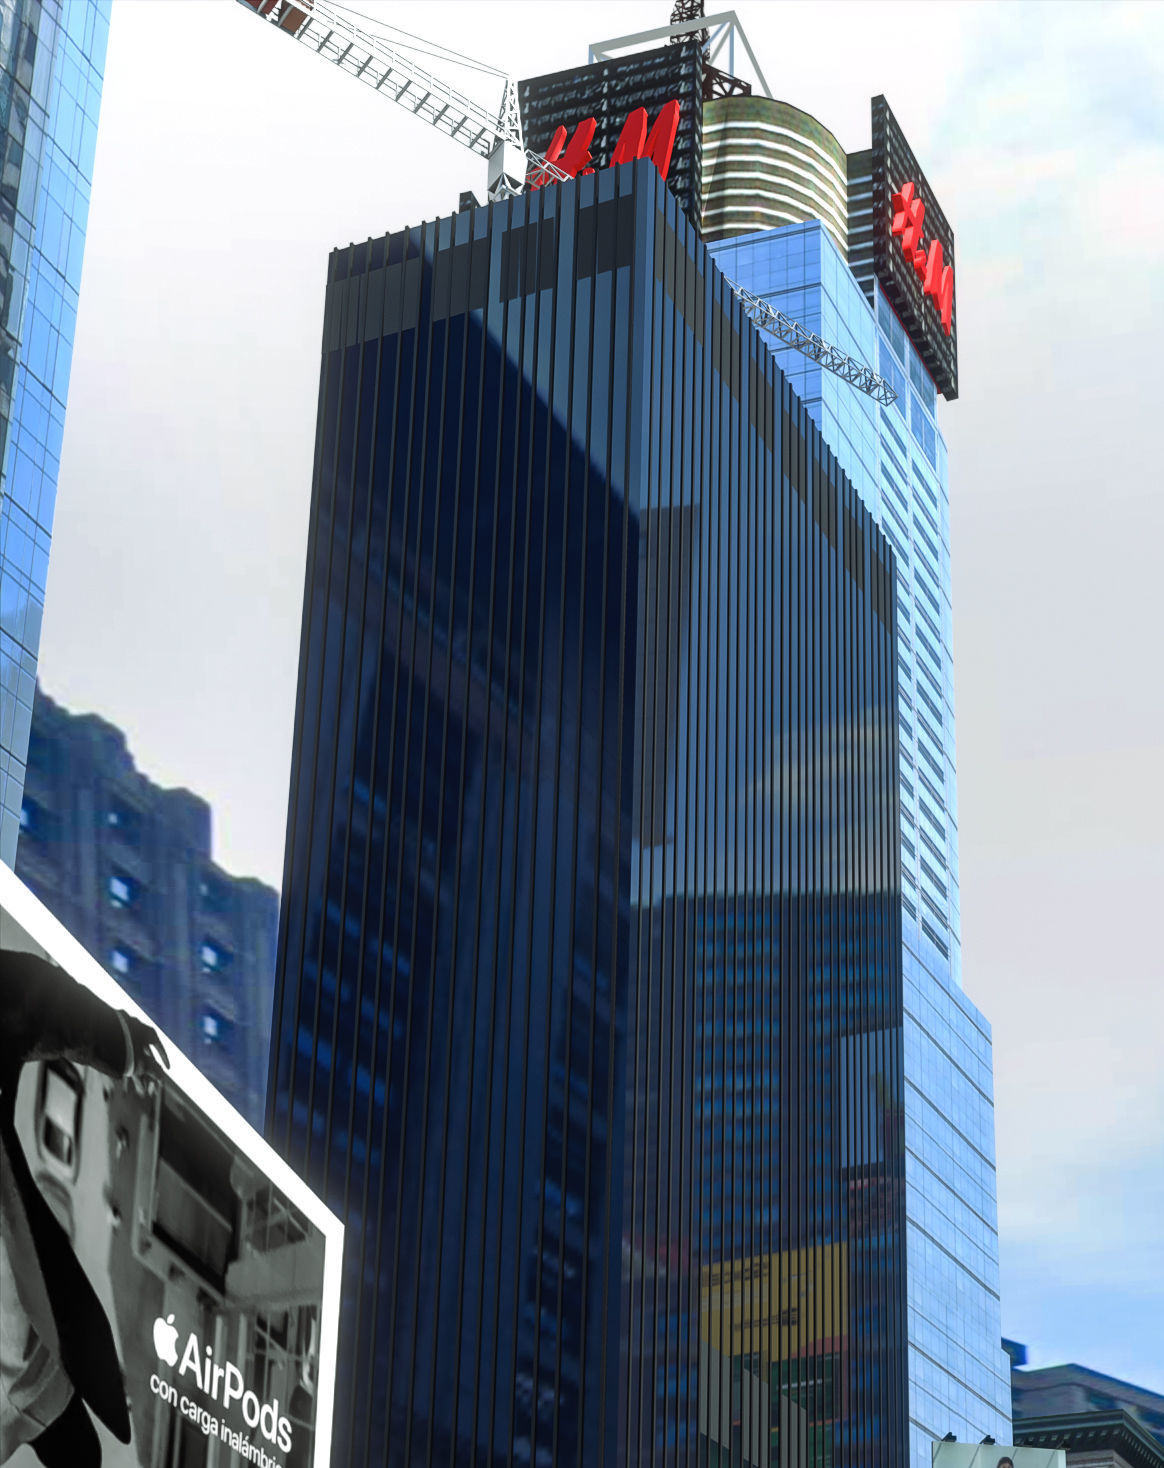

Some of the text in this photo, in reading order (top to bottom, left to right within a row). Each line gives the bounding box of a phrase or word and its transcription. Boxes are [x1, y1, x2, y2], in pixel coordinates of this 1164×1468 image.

[891, 182, 954, 337] H&M
[150, 1373, 178, 1408] con
[180, 1395, 219, 1436] carga
[178, 1332, 293, 1454] AirPods
